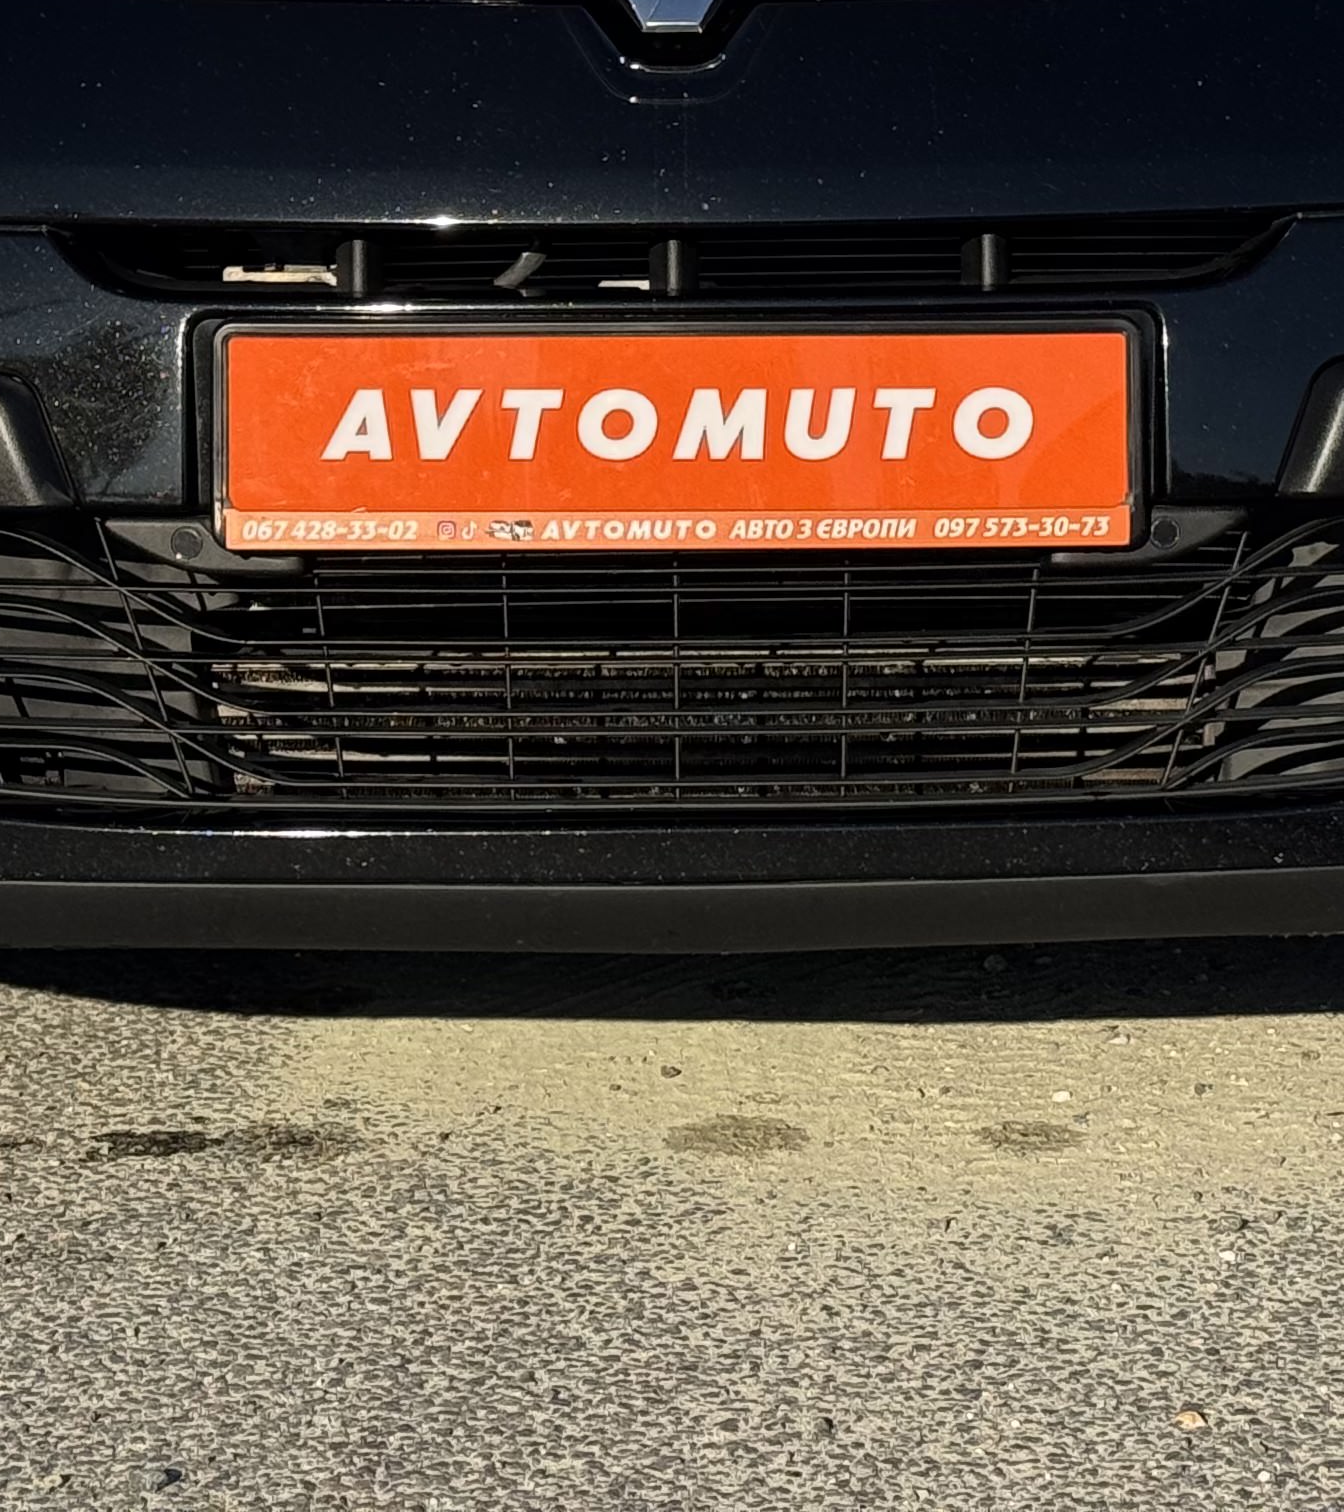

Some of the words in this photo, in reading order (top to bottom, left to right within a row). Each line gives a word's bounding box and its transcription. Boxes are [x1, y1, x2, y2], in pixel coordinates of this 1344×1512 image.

[319, 387, 1035, 461] AVTOMUTO
[241, 519, 285, 541] 067
[291, 518, 419, 541] 428-33-02
[540, 519, 718, 541] AVTOMUTO
[728, 518, 795, 541] АВТО
[815, 517, 917, 540] ЄВРОПИ
[933, 517, 979, 539] 097
[982, 516, 1112, 539] 573-30-73
